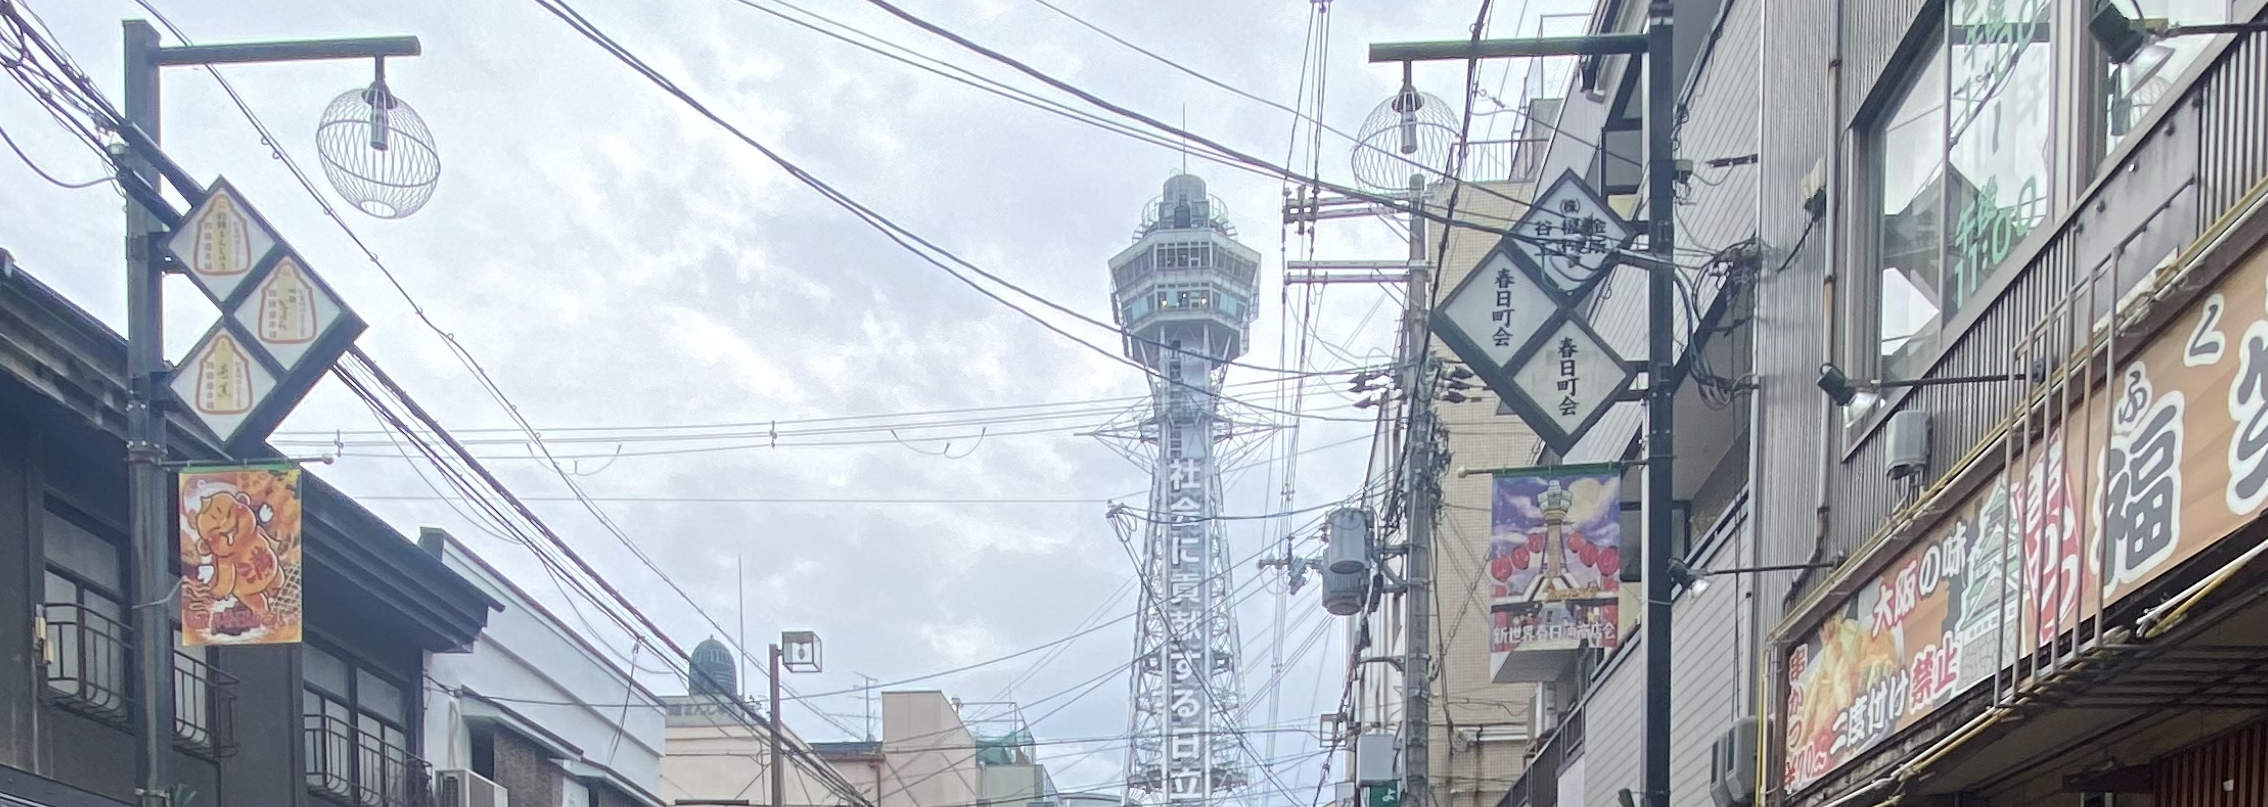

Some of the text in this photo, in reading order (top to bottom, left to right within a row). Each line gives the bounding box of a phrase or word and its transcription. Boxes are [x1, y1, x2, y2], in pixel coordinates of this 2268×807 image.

[1954, 175, 2037, 311] 11:00
[1491, 267, 1516, 348] 春日町会
[1556, 336, 1581, 417] 春日町会
[1169, 458, 1202, 797] 社会に貢献する日立
[1873, 521, 1967, 637] 大阪の味
[1789, 644, 1807, 749] 串かつ
[1830, 631, 1960, 755] 二度付け禁止
